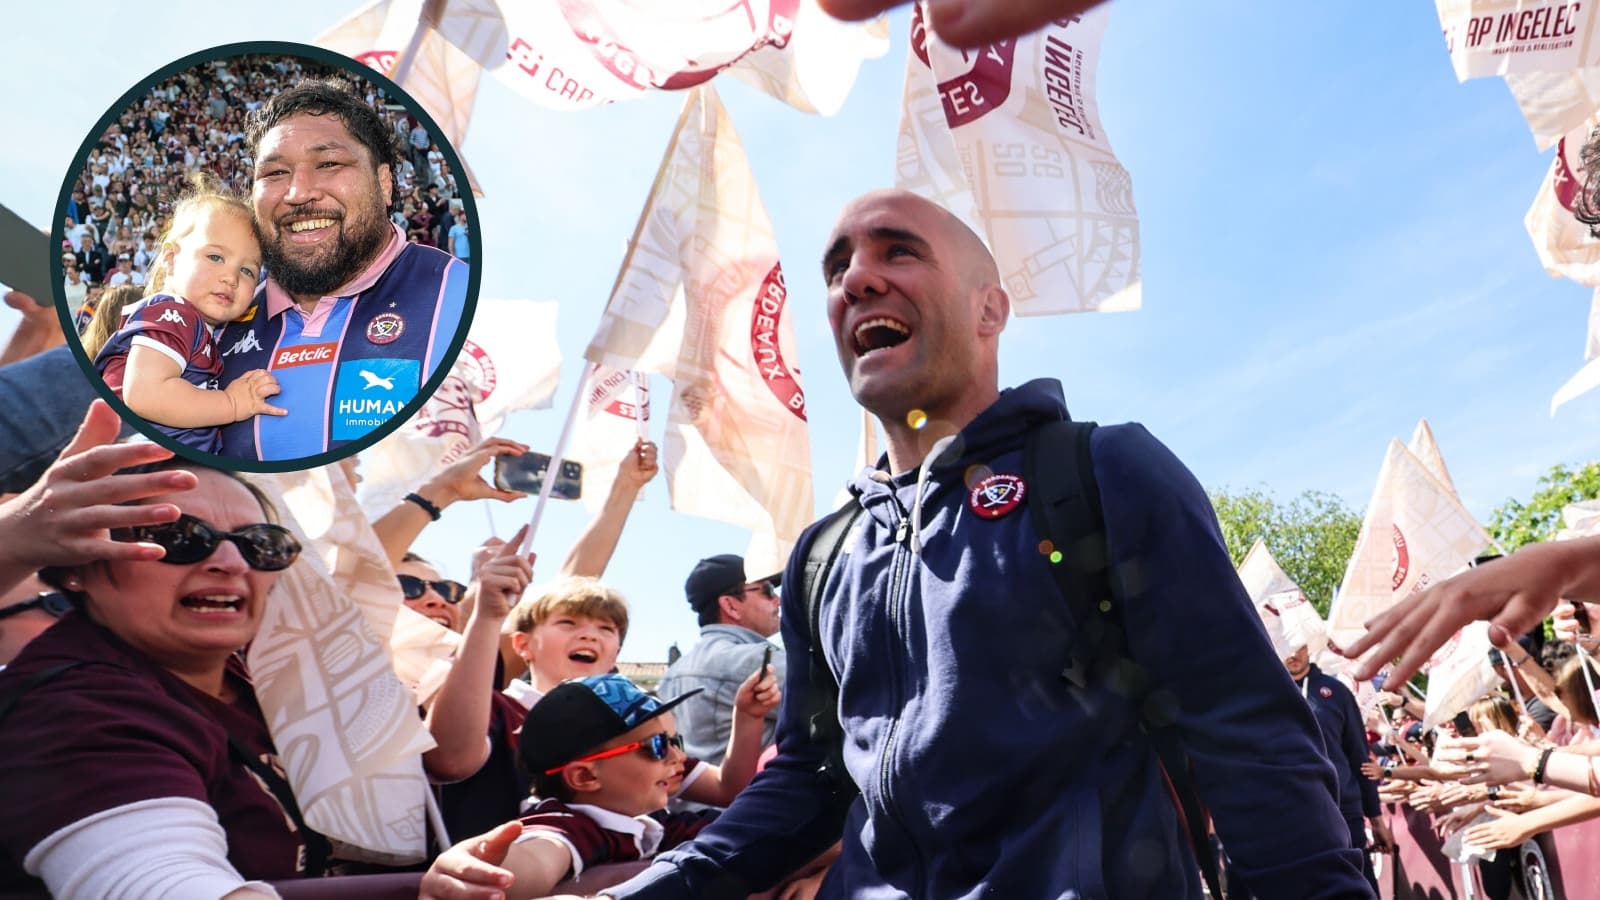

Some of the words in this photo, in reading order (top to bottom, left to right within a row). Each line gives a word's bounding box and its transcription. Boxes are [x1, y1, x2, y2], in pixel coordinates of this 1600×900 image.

[1466, 16, 1494, 48] AP
[1495, 2, 1580, 44] INGELEC
[277, 346, 332, 365] Betclic
[346, 418, 389, 427] Immobi
